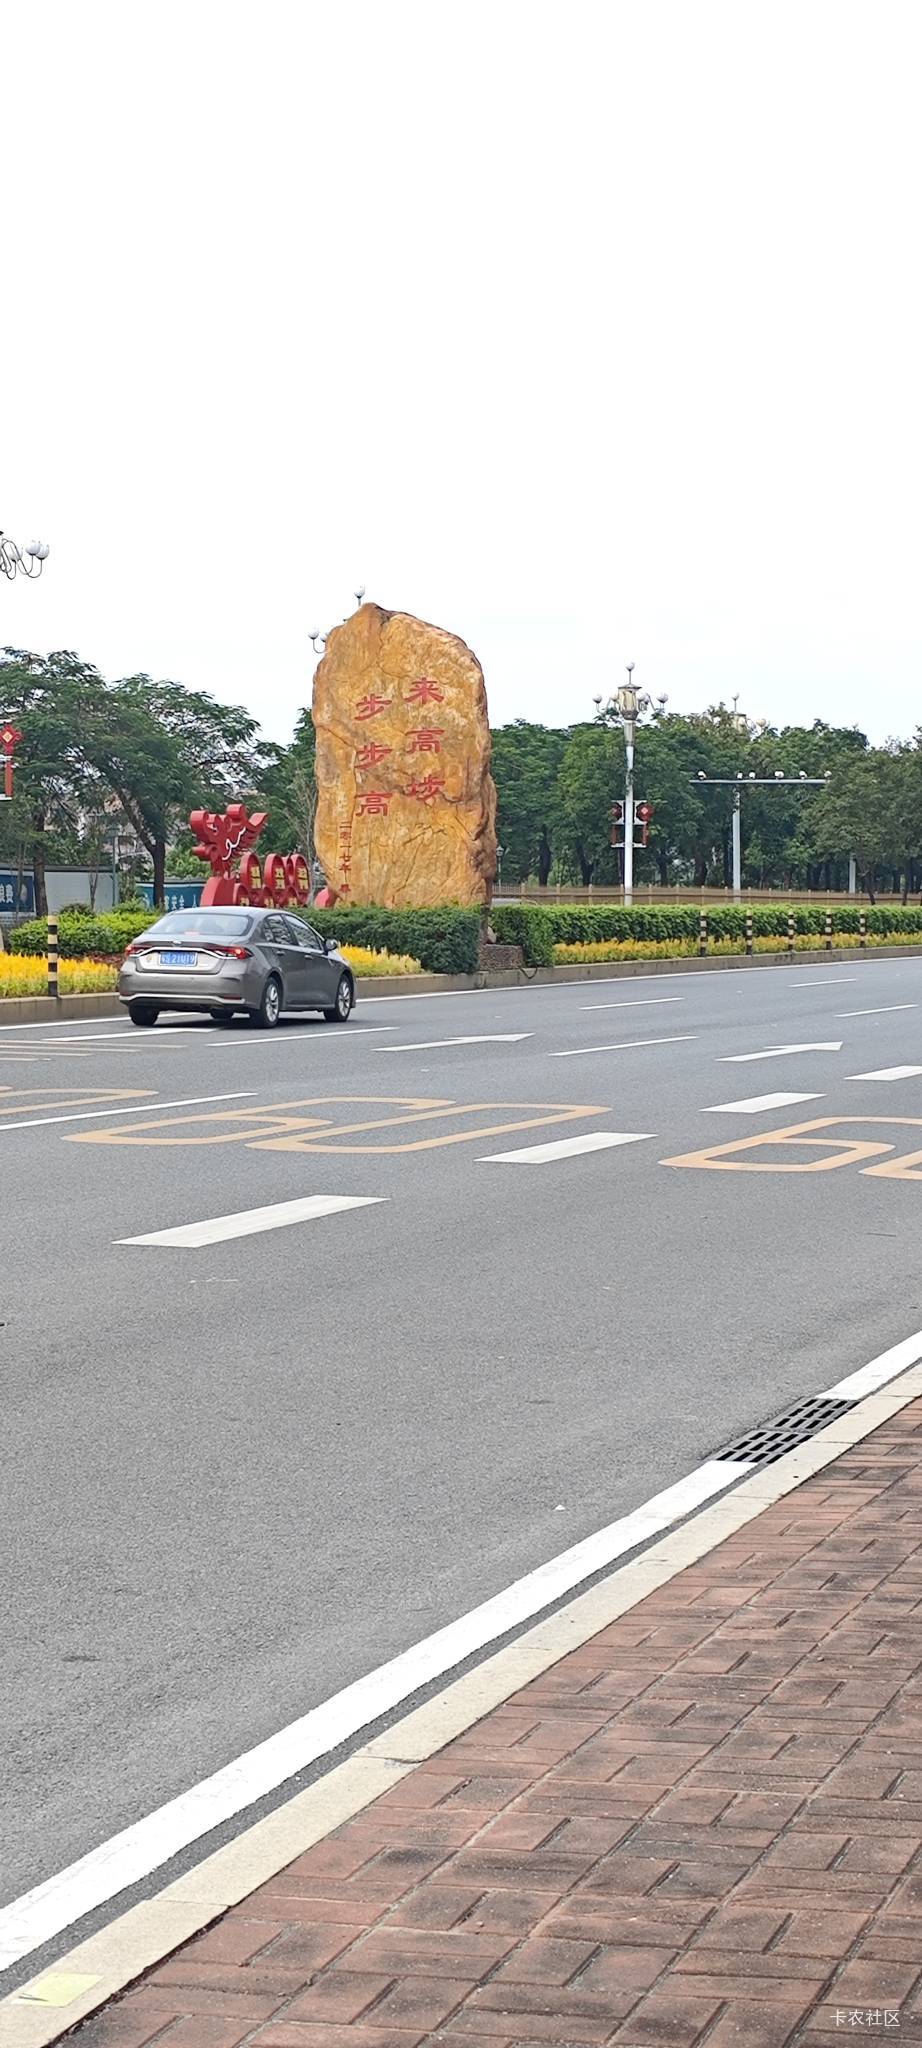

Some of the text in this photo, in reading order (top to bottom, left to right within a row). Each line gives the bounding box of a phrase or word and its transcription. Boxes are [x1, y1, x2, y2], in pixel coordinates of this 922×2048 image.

[354, 693, 392, 816] 步步高
[60, 1097, 611, 1153] 60
